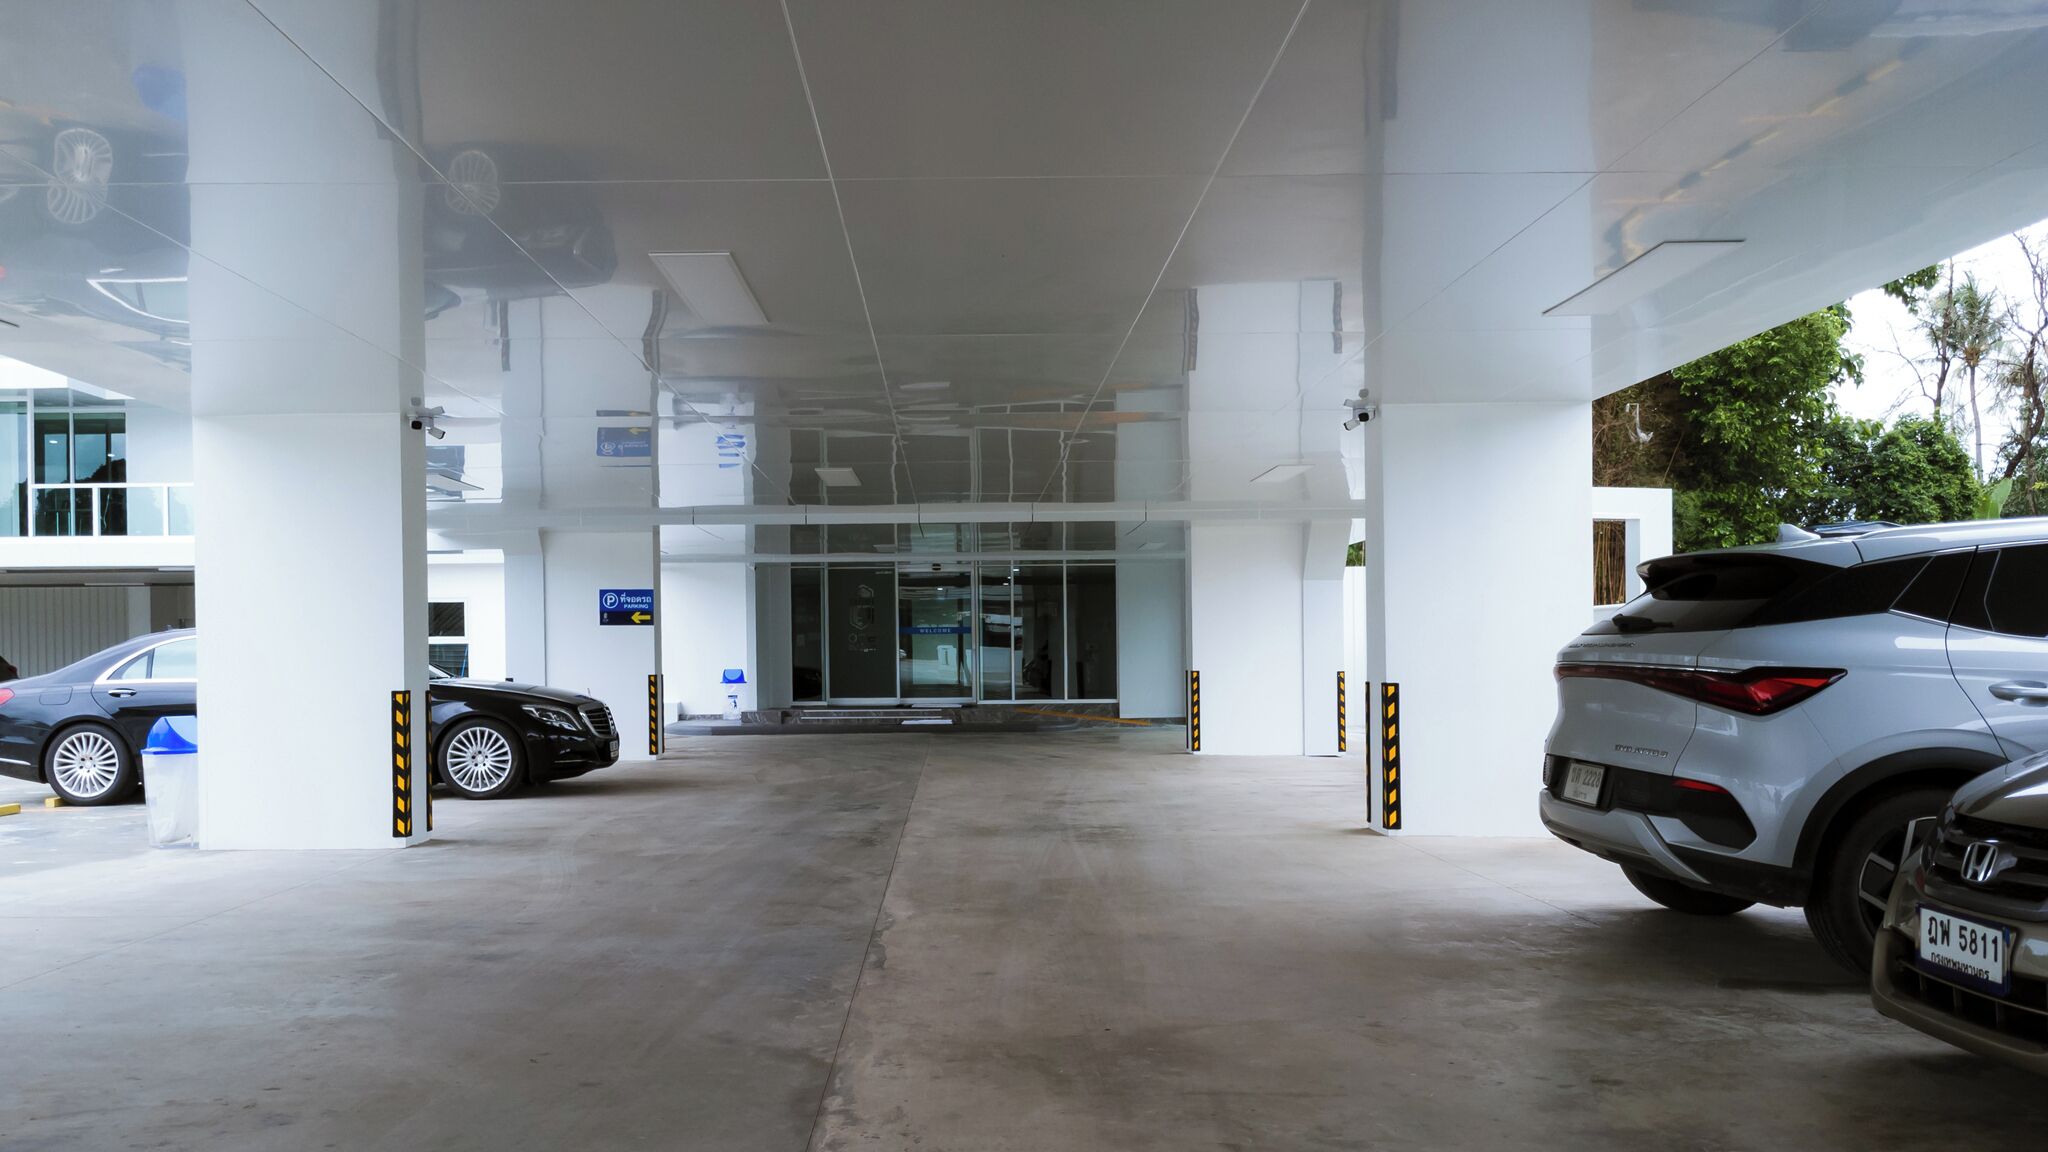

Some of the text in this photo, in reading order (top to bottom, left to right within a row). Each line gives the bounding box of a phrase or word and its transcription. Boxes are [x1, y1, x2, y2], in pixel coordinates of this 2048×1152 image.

[607, 595, 616, 606] P
[620, 592, 652, 603] ที่จอดรถ
[1959, 925, 1998, 963] 5811
